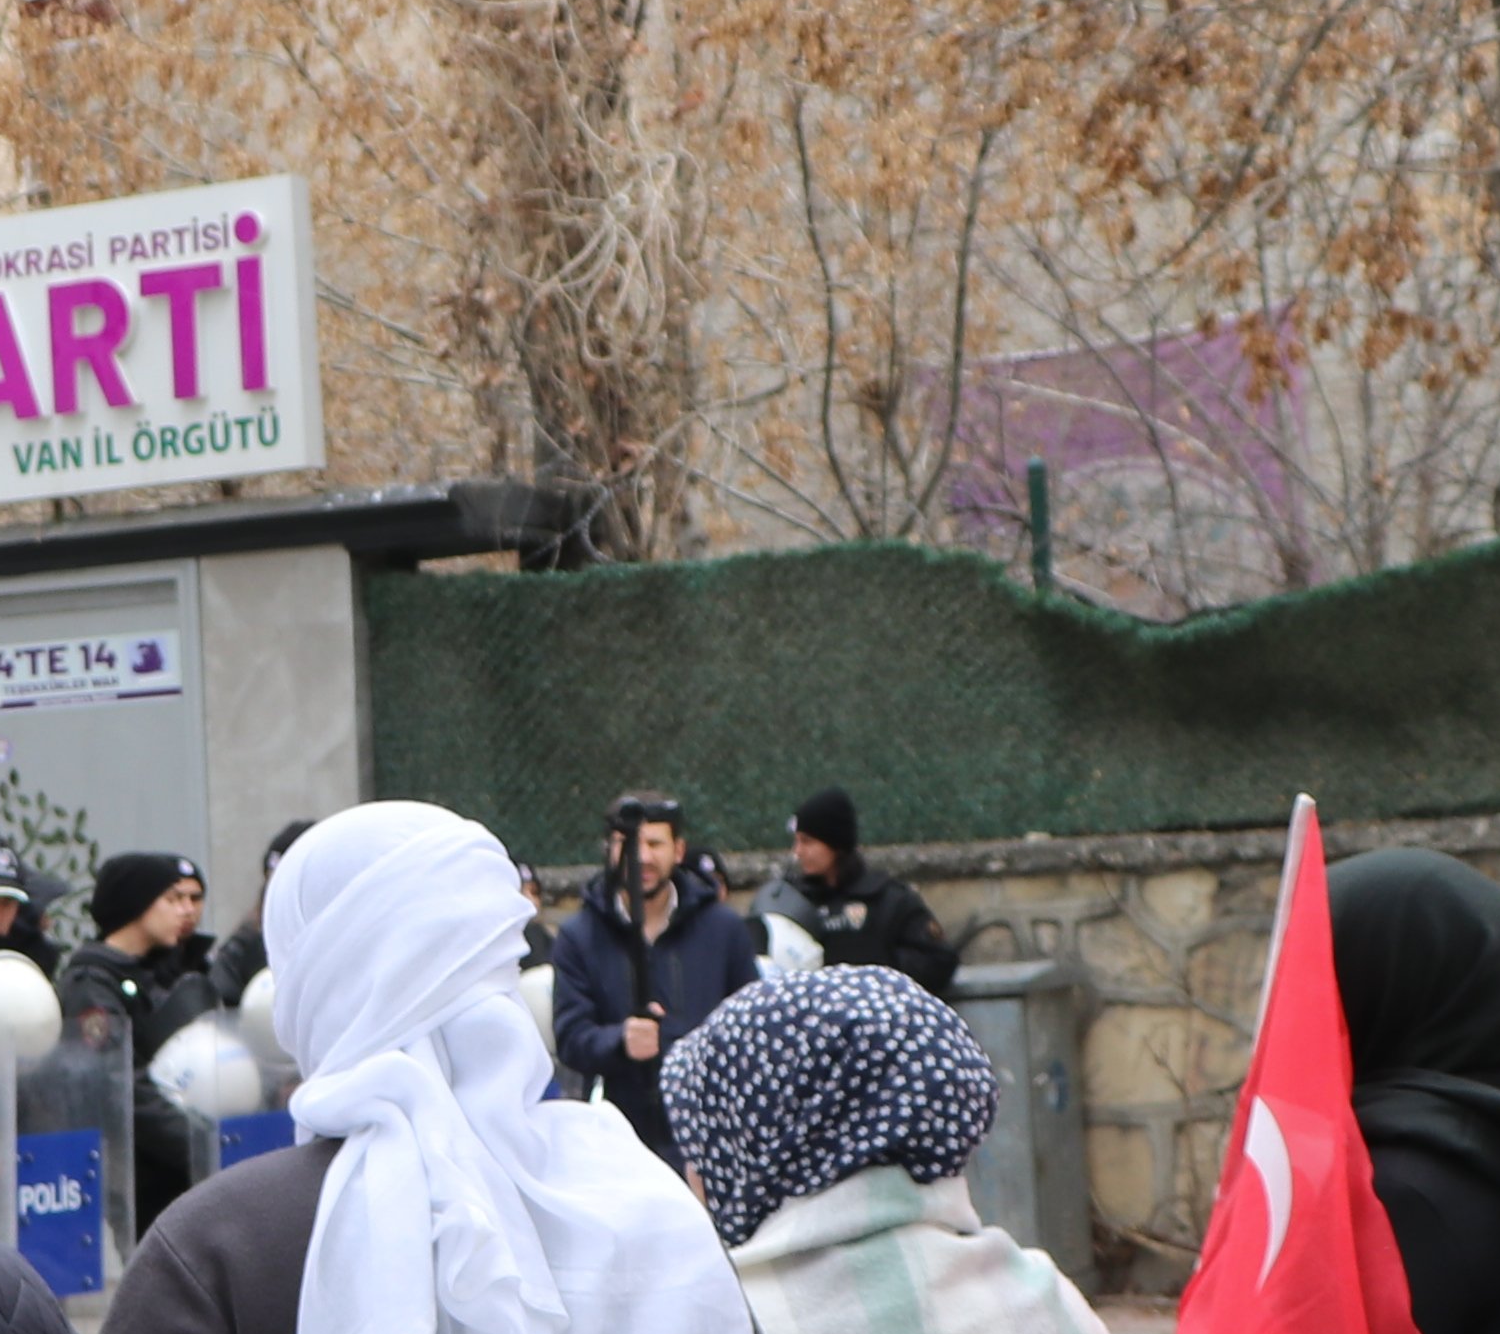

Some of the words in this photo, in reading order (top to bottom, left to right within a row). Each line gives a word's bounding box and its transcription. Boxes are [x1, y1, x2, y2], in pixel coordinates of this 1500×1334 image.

[109, 214, 231, 264] PARTİSİ
[12, 437, 83, 475] VAN
[94, 427, 123, 465] İL
[132, 406, 281, 462] ÖRGÜTÜ
[79, 641, 117, 671] 14
[18, 1173, 82, 1216] POLİS
